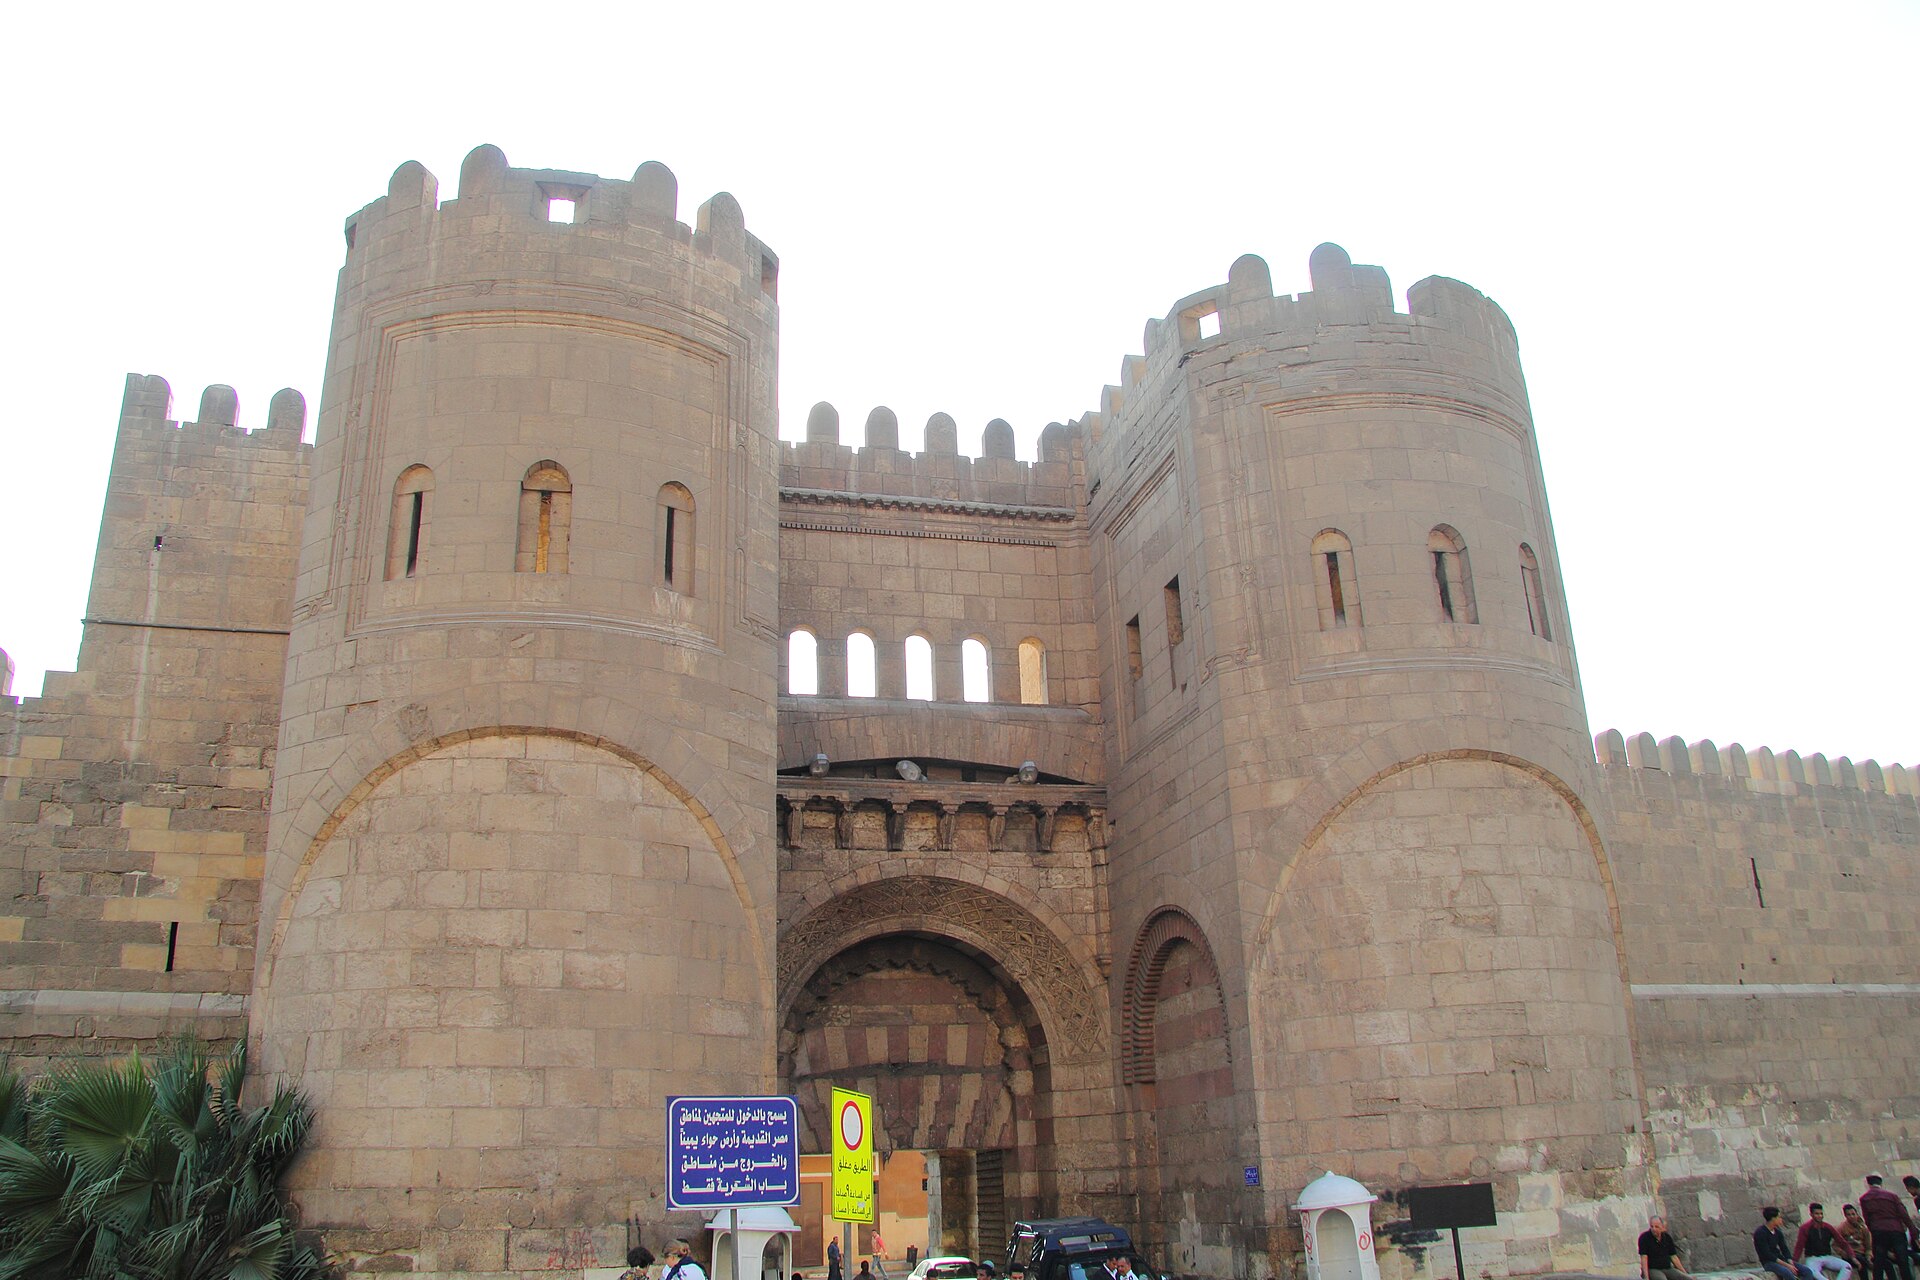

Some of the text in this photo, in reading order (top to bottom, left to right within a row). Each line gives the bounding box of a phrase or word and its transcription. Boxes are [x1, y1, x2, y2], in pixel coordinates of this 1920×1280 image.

[680, 1108, 701, 1125] لمناطق
[736, 1107, 766, 1125] بالدخول
[768, 1110, 787, 1126] يسمح
[701, 1132, 718, 1149] حواء
[720, 1130, 739, 1149] وأرض
[741, 1130, 770, 1149] القديمة
[772, 1134, 788, 1147] مصر
[681, 1153, 787, 1173] والخروج من مناطق
[838, 1156, 870, 1174] الطريق مغلق
[682, 1175, 787, 1196] باب الشعرية فقط
[846, 1184, 849, 1196] ٩
[850, 1190, 862, 1198] الساعة
